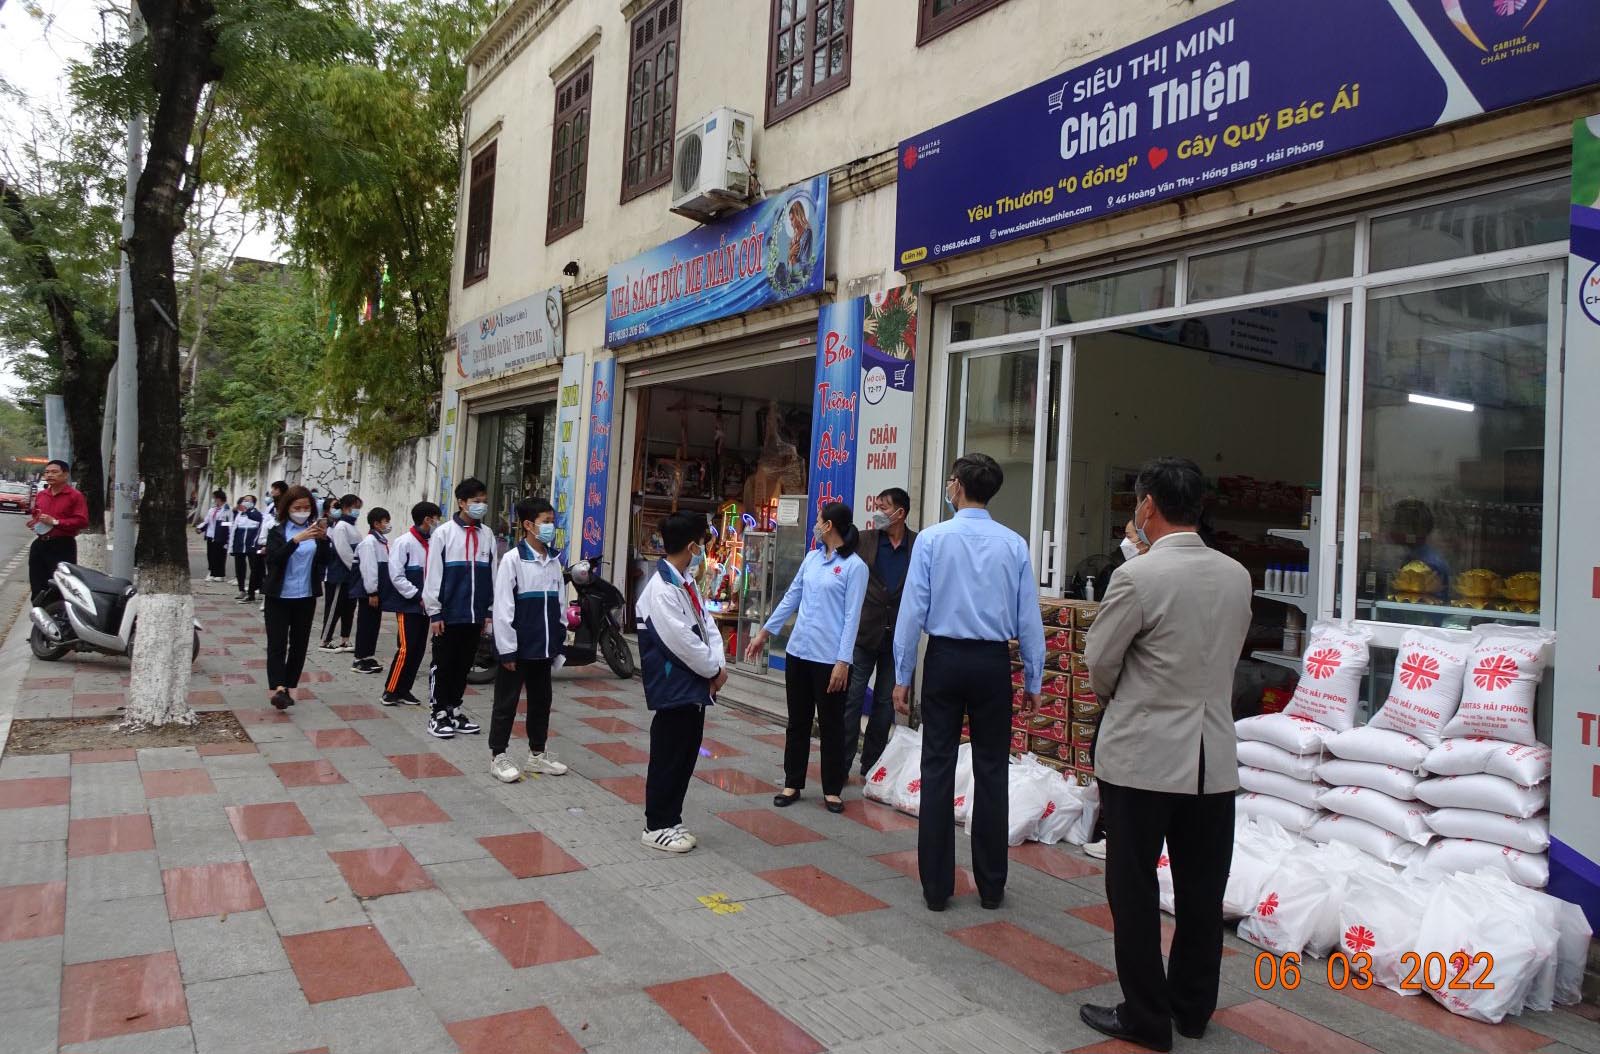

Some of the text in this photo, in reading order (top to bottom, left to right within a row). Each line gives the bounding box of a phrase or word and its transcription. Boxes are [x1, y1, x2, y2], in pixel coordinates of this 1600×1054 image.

[1072, 18, 1235, 103] SIÊU THỊ MINI
[1493, 36, 1527, 52] CARITAS
[1060, 60, 1250, 160] Chân Thiện
[967, 201, 993, 224] Yêu
[996, 185, 1054, 216] Thương
[1177, 132, 1217, 160] Gây
[1222, 116, 1270, 144] Quỹ
[1276, 100, 1324, 131] Bác
[1330, 83, 1361, 113] Ái
[997, 204, 1092, 237] www.sieuthichanthien.com
[1115, 194, 1127, 205] 46
[1128, 184, 1156, 202] Hoàng
[1176, 175, 1194, 188] Thụ
[1231, 158, 1257, 174] Bàng
[1266, 149, 1284, 163] Hải
[1286, 140, 1325, 158] Phòng
[610, 275, 631, 320] NHÀ
[632, 267, 659, 314] SÁCH
[525, 328, 543, 347] TRANG
[824, 331, 855, 368] Bán
[818, 425, 849, 470] Ảnh
[869, 424, 898, 445] CHÂN
[867, 447, 897, 471] PHẨM
[1483, 702, 1498, 711] HẢI
[1500, 705, 1529, 714] PHÒNG
